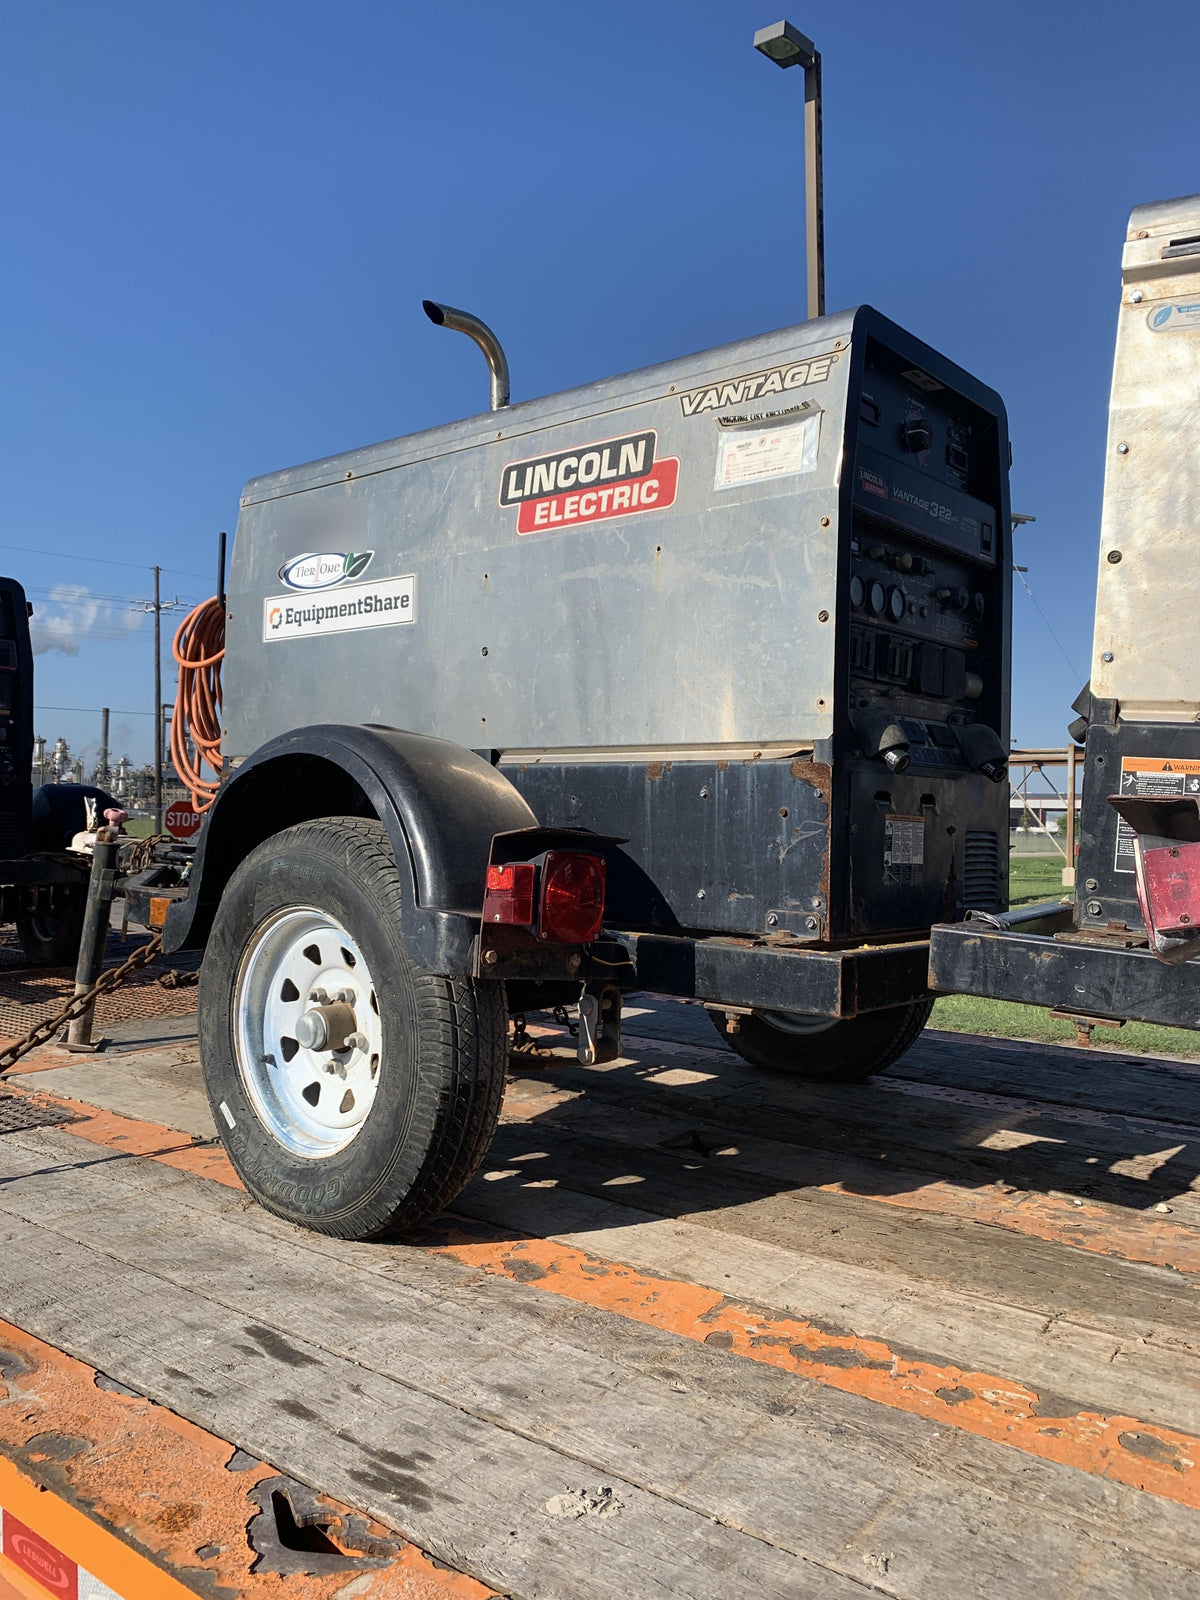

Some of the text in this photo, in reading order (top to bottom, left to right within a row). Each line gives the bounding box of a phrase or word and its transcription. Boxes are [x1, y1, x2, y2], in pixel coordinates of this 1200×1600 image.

[680, 356, 832, 417] VANTAGE
[507, 439, 647, 500] LINCOLN
[534, 479, 660, 526] ELECTRIC
[892, 486, 952, 521] VANTAGE 322
[285, 594, 409, 627] EquipmentShare
[166, 811, 200, 827] STOP
[22, 1543, 58, 1578] LEDWELL
